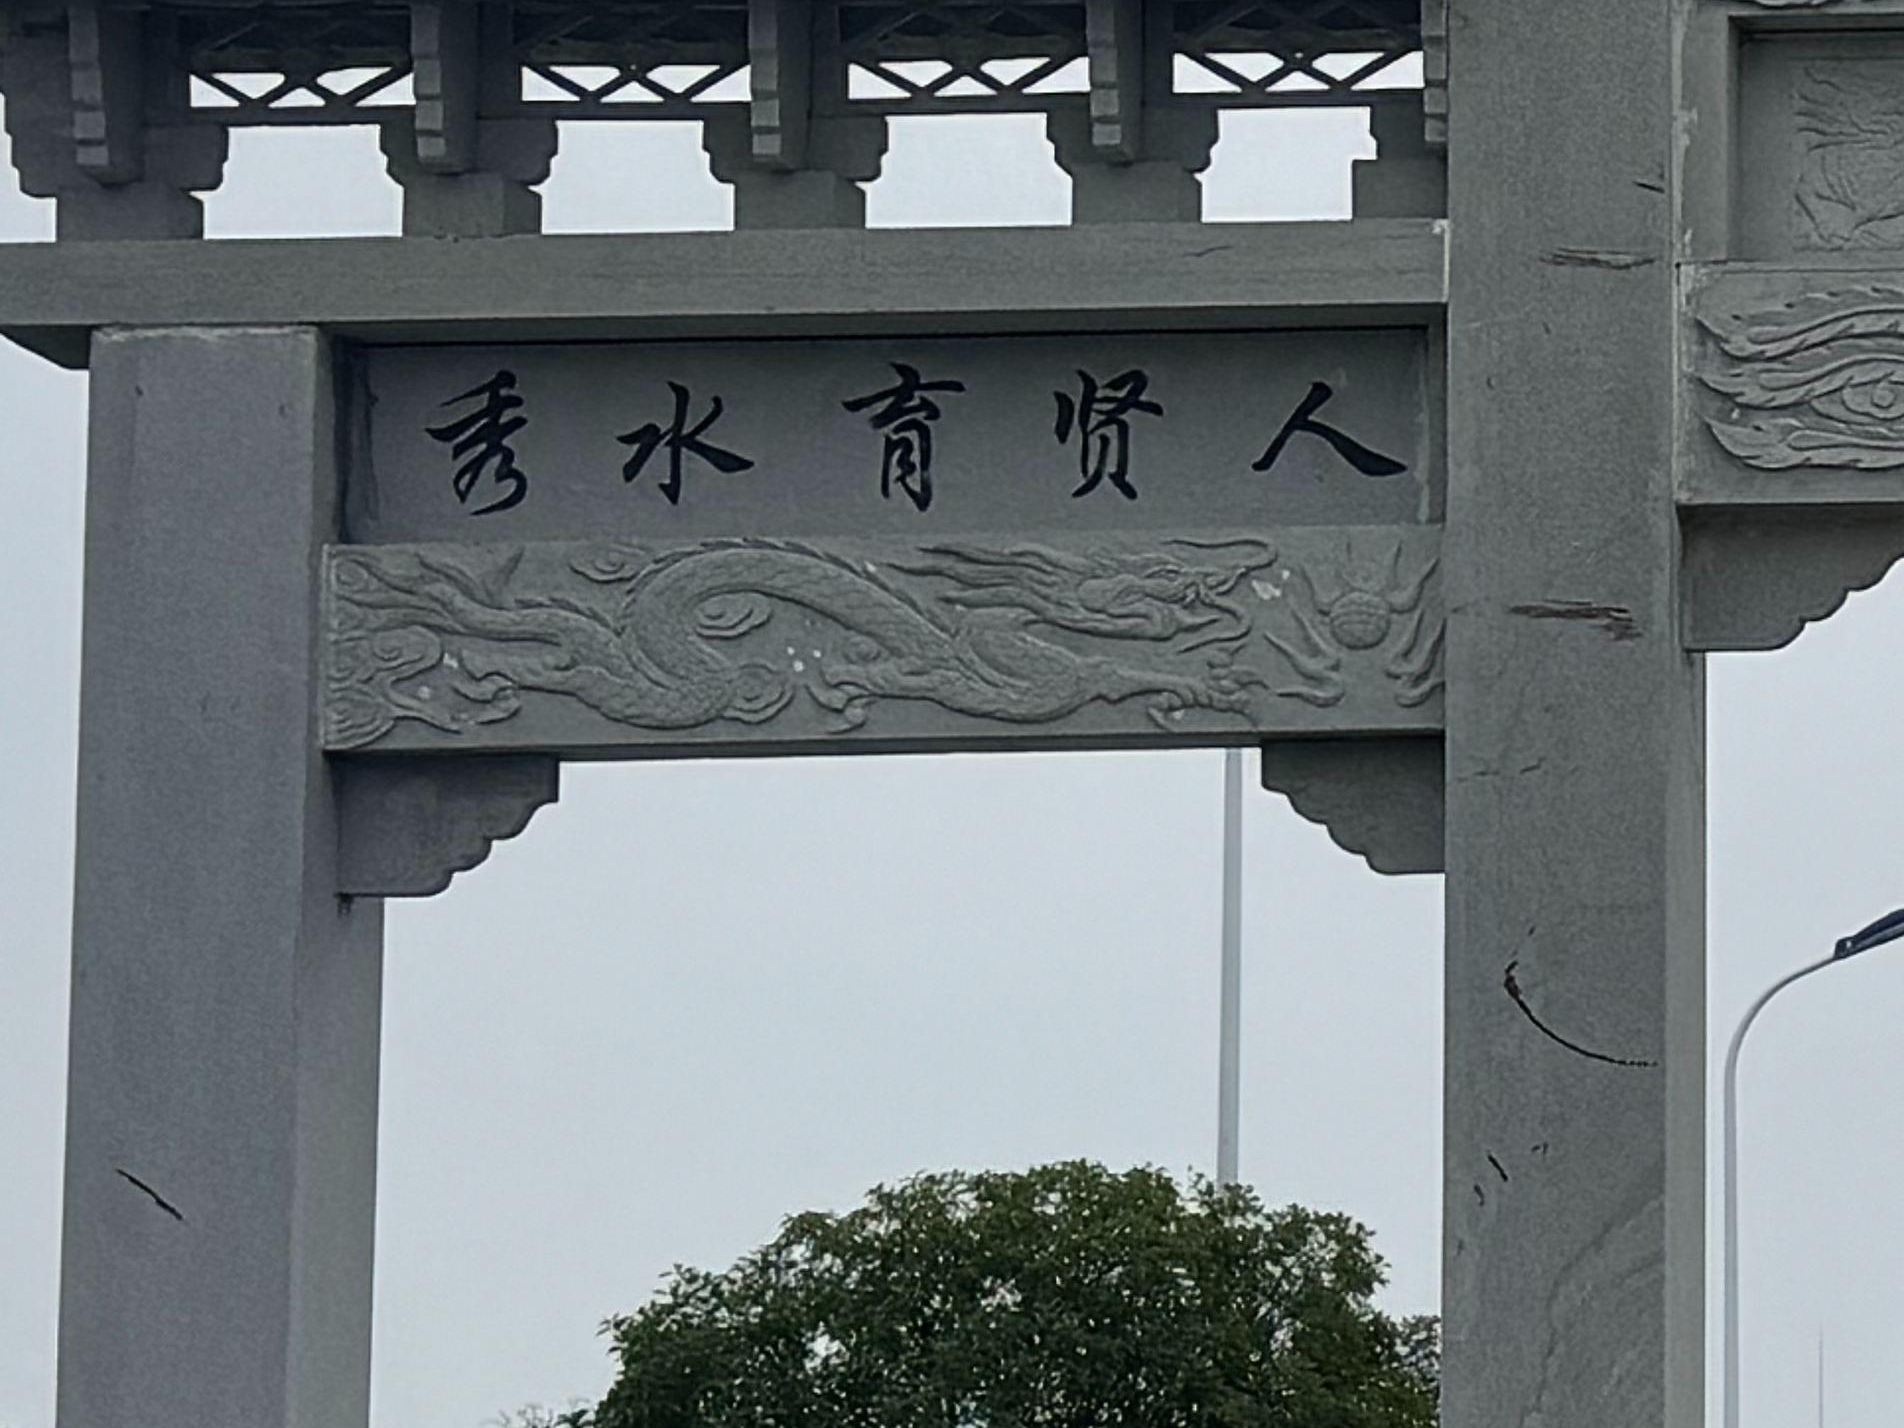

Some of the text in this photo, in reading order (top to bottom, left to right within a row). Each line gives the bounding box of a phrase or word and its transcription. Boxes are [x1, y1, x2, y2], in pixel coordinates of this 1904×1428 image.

[424, 363, 1408, 516] 秀水育贤人
